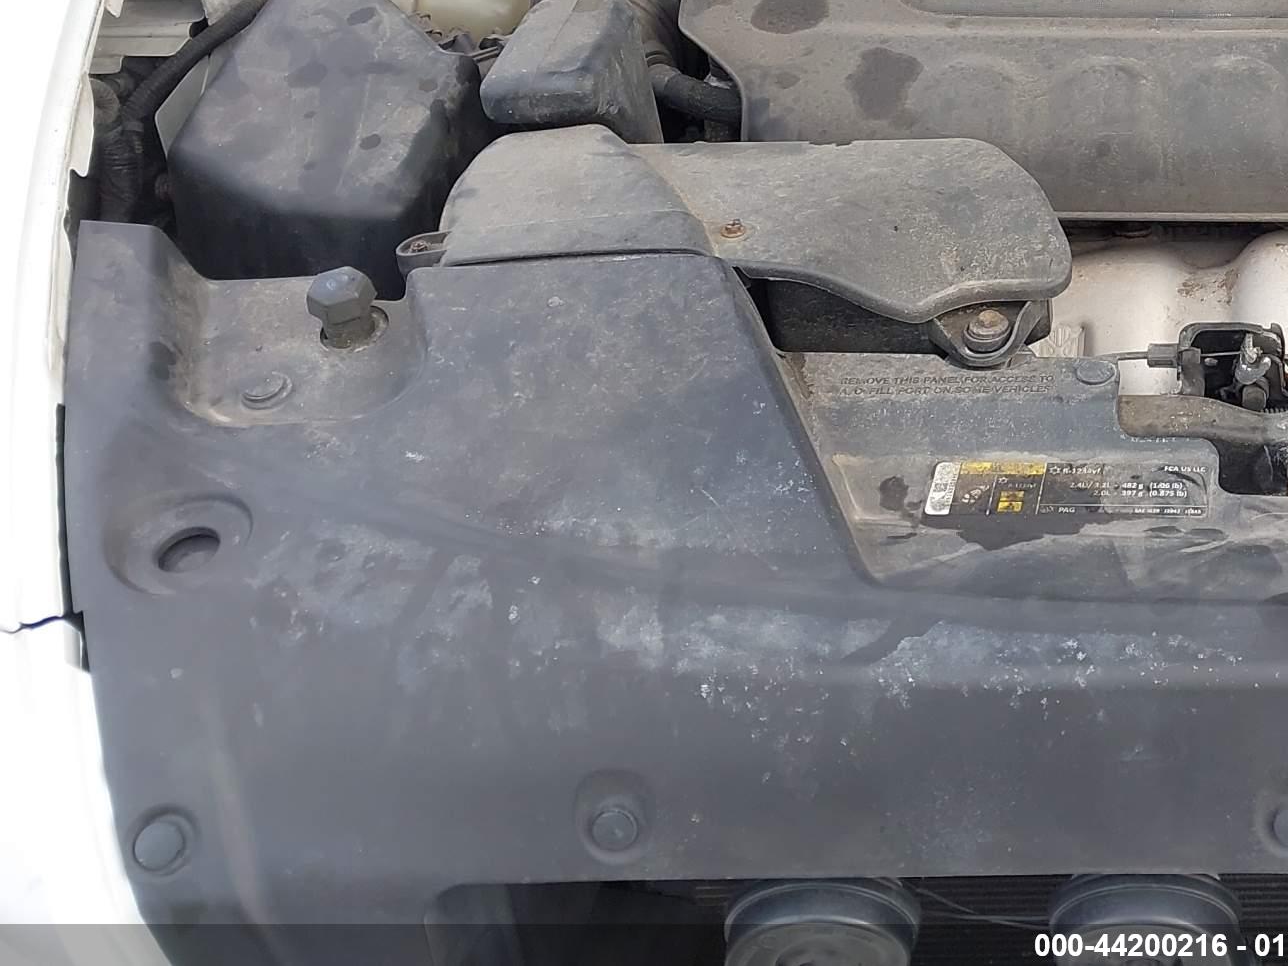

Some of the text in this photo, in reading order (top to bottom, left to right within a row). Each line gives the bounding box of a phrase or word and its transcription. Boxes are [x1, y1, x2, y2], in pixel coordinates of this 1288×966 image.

[894, 376, 920, 384] THIS
[923, 376, 961, 384] PANEL
[964, 375, 988, 383] FOR
[991, 375, 1036, 383] ACCESS
[1039, 374, 1054, 383] TO
[868, 387, 893, 395] FILL
[898, 386, 930, 395] PORT
[933, 386, 951, 394] ON
[991, 385, 1051, 394] VEHICLES
[1171, 481, 1183, 490] lb)
[1176, 490, 1188, 498] lb)
